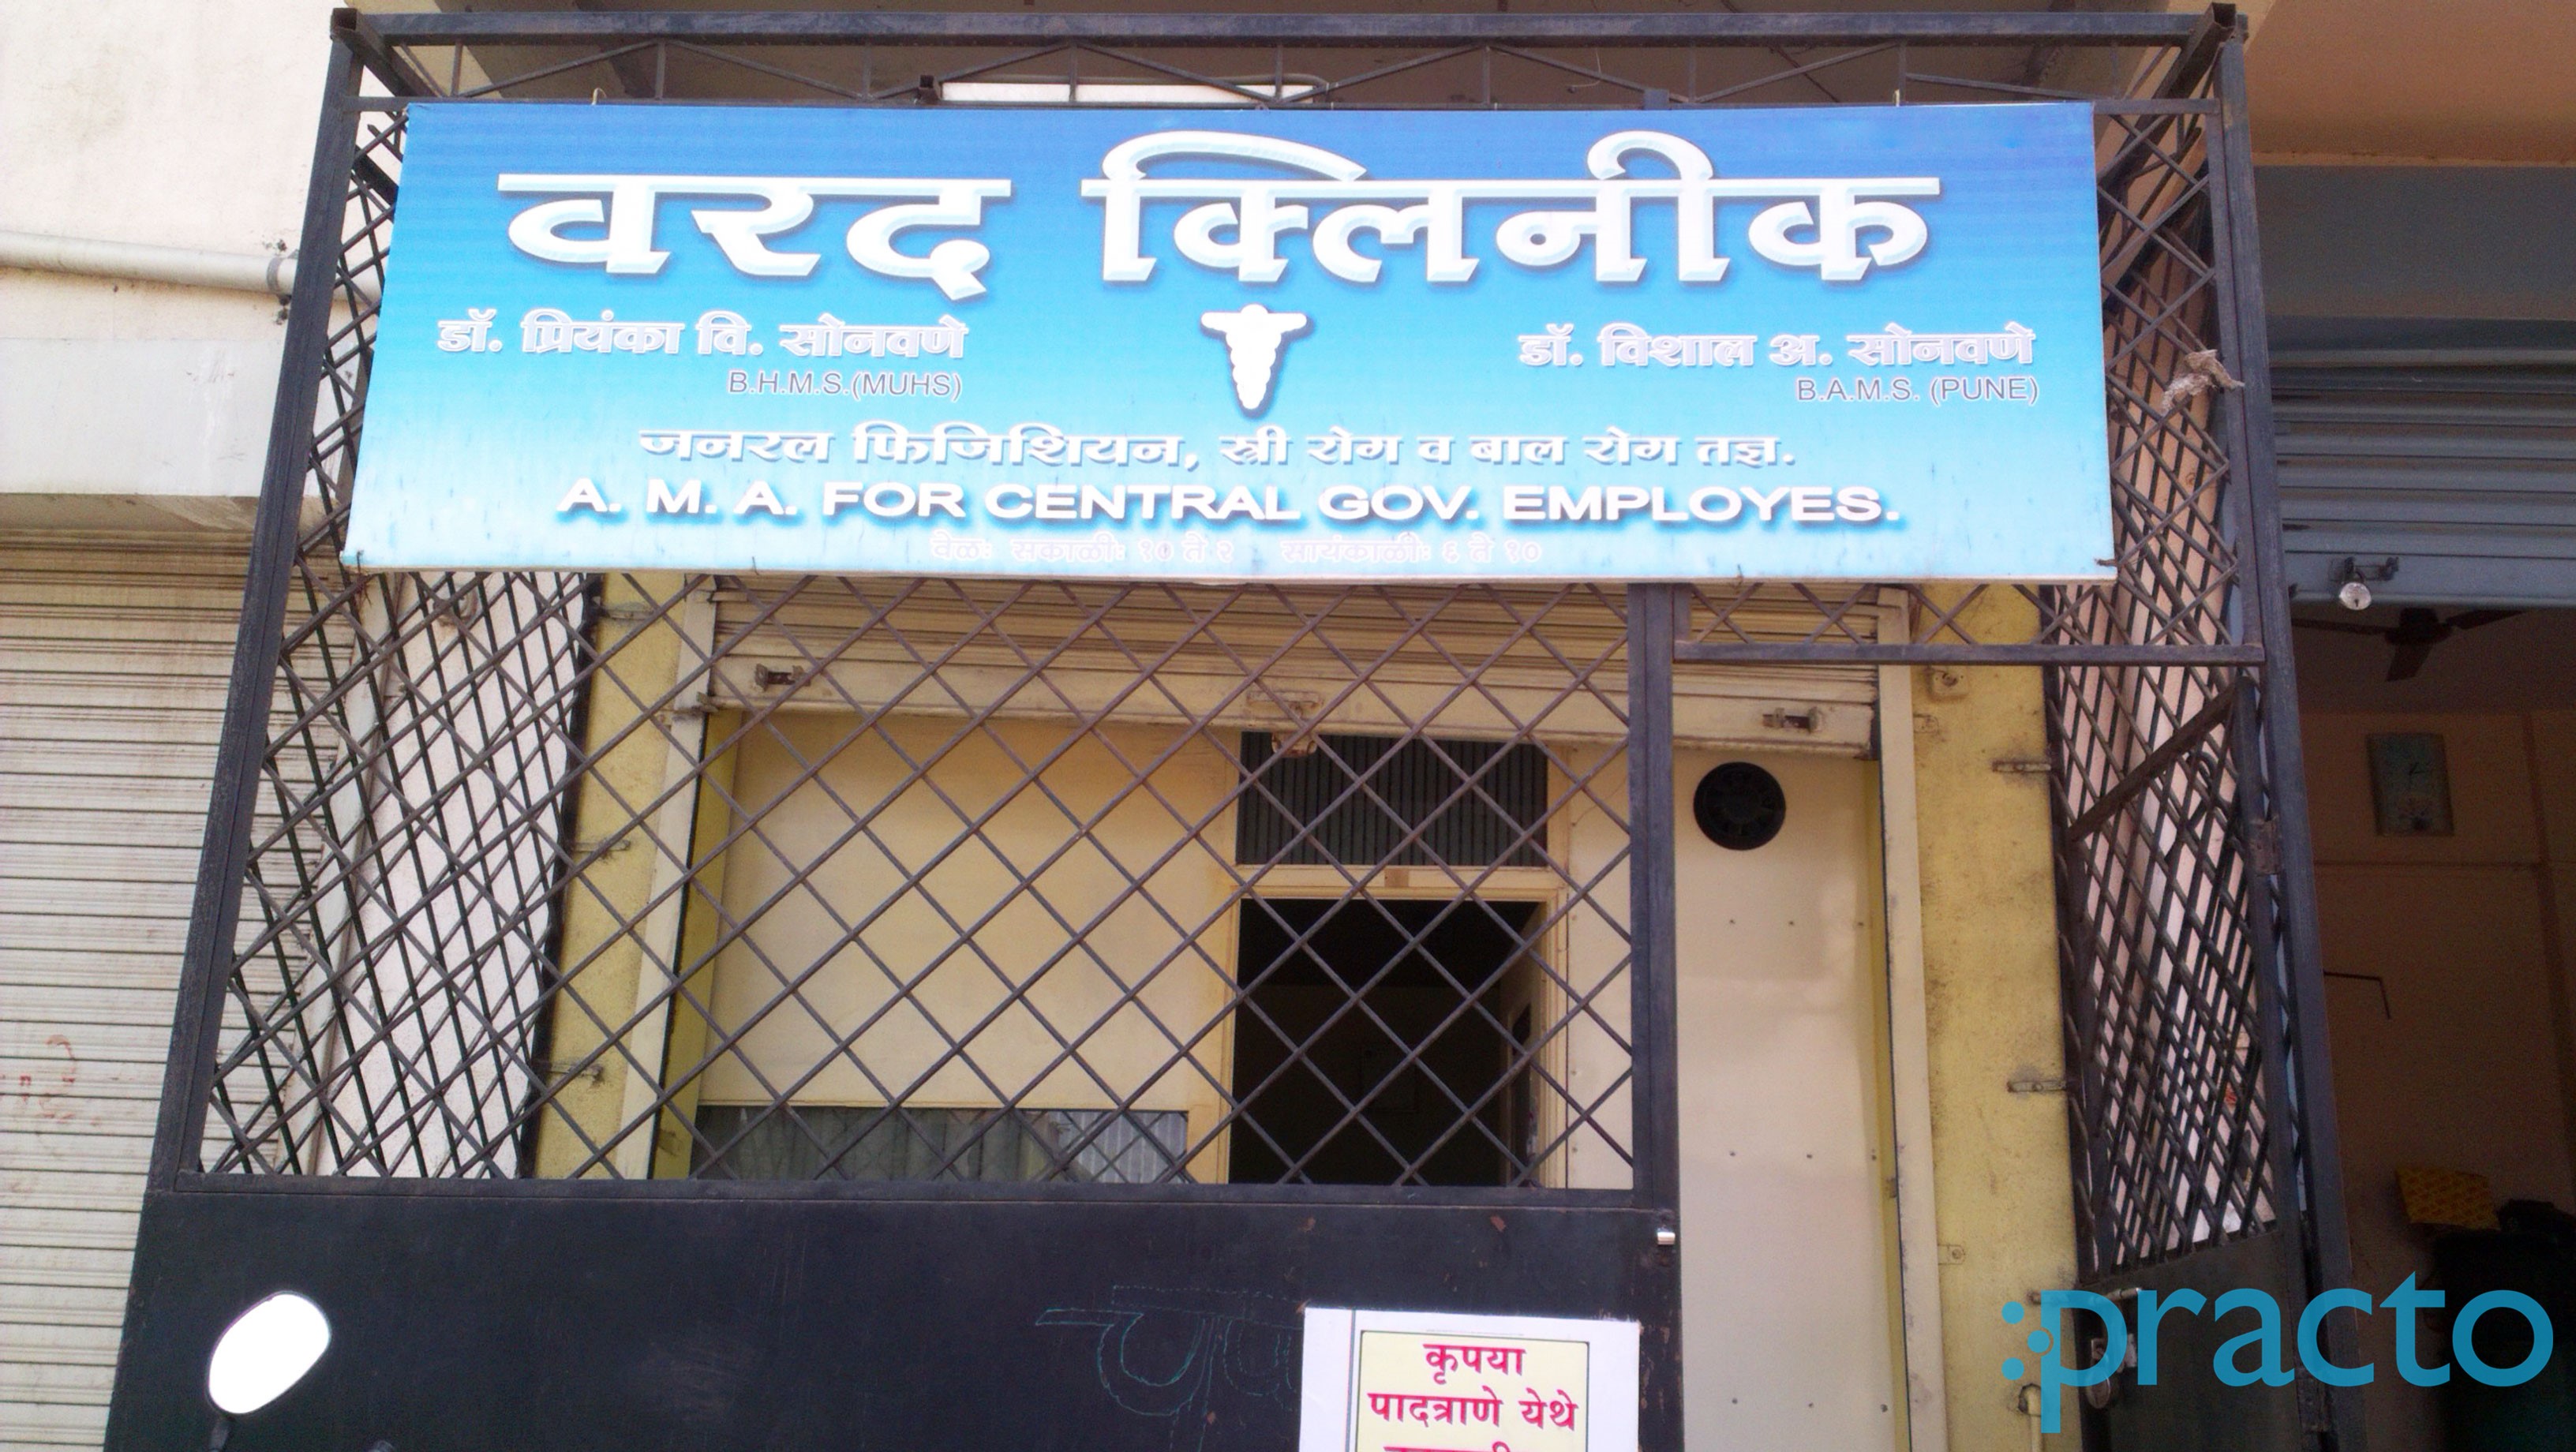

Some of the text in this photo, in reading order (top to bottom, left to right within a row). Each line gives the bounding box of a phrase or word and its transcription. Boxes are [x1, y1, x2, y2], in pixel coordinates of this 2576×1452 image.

[496, 130, 1941, 301] वरद क्लिनीक
[437, 309, 969, 358] डॉ. प्रियंका वि. सोनवणे
[1518, 320, 2036, 367] डॉ. विशाल अ. सोनवणे
[1797, 376, 2039, 406] B.A.M.S. (PUNE)
[639, 421, 1795, 470] जनरल फिजिशियन, स्त्री रोग व बाल रोग तज्ञ.
[557, 478, 1900, 522] A. M. A. FOR CENTRAL GOV. EMPLOYES.
[1181, 530, 1208, 562] ते
[1215, 540, 1234, 562] २
[1468, 531, 1493, 562] ते
[1504, 539, 1542, 563] १०
[1423, 1343, 1526, 1384] कृपया
[1366, 1385, 1579, 1430] पादत्राणे येथे
